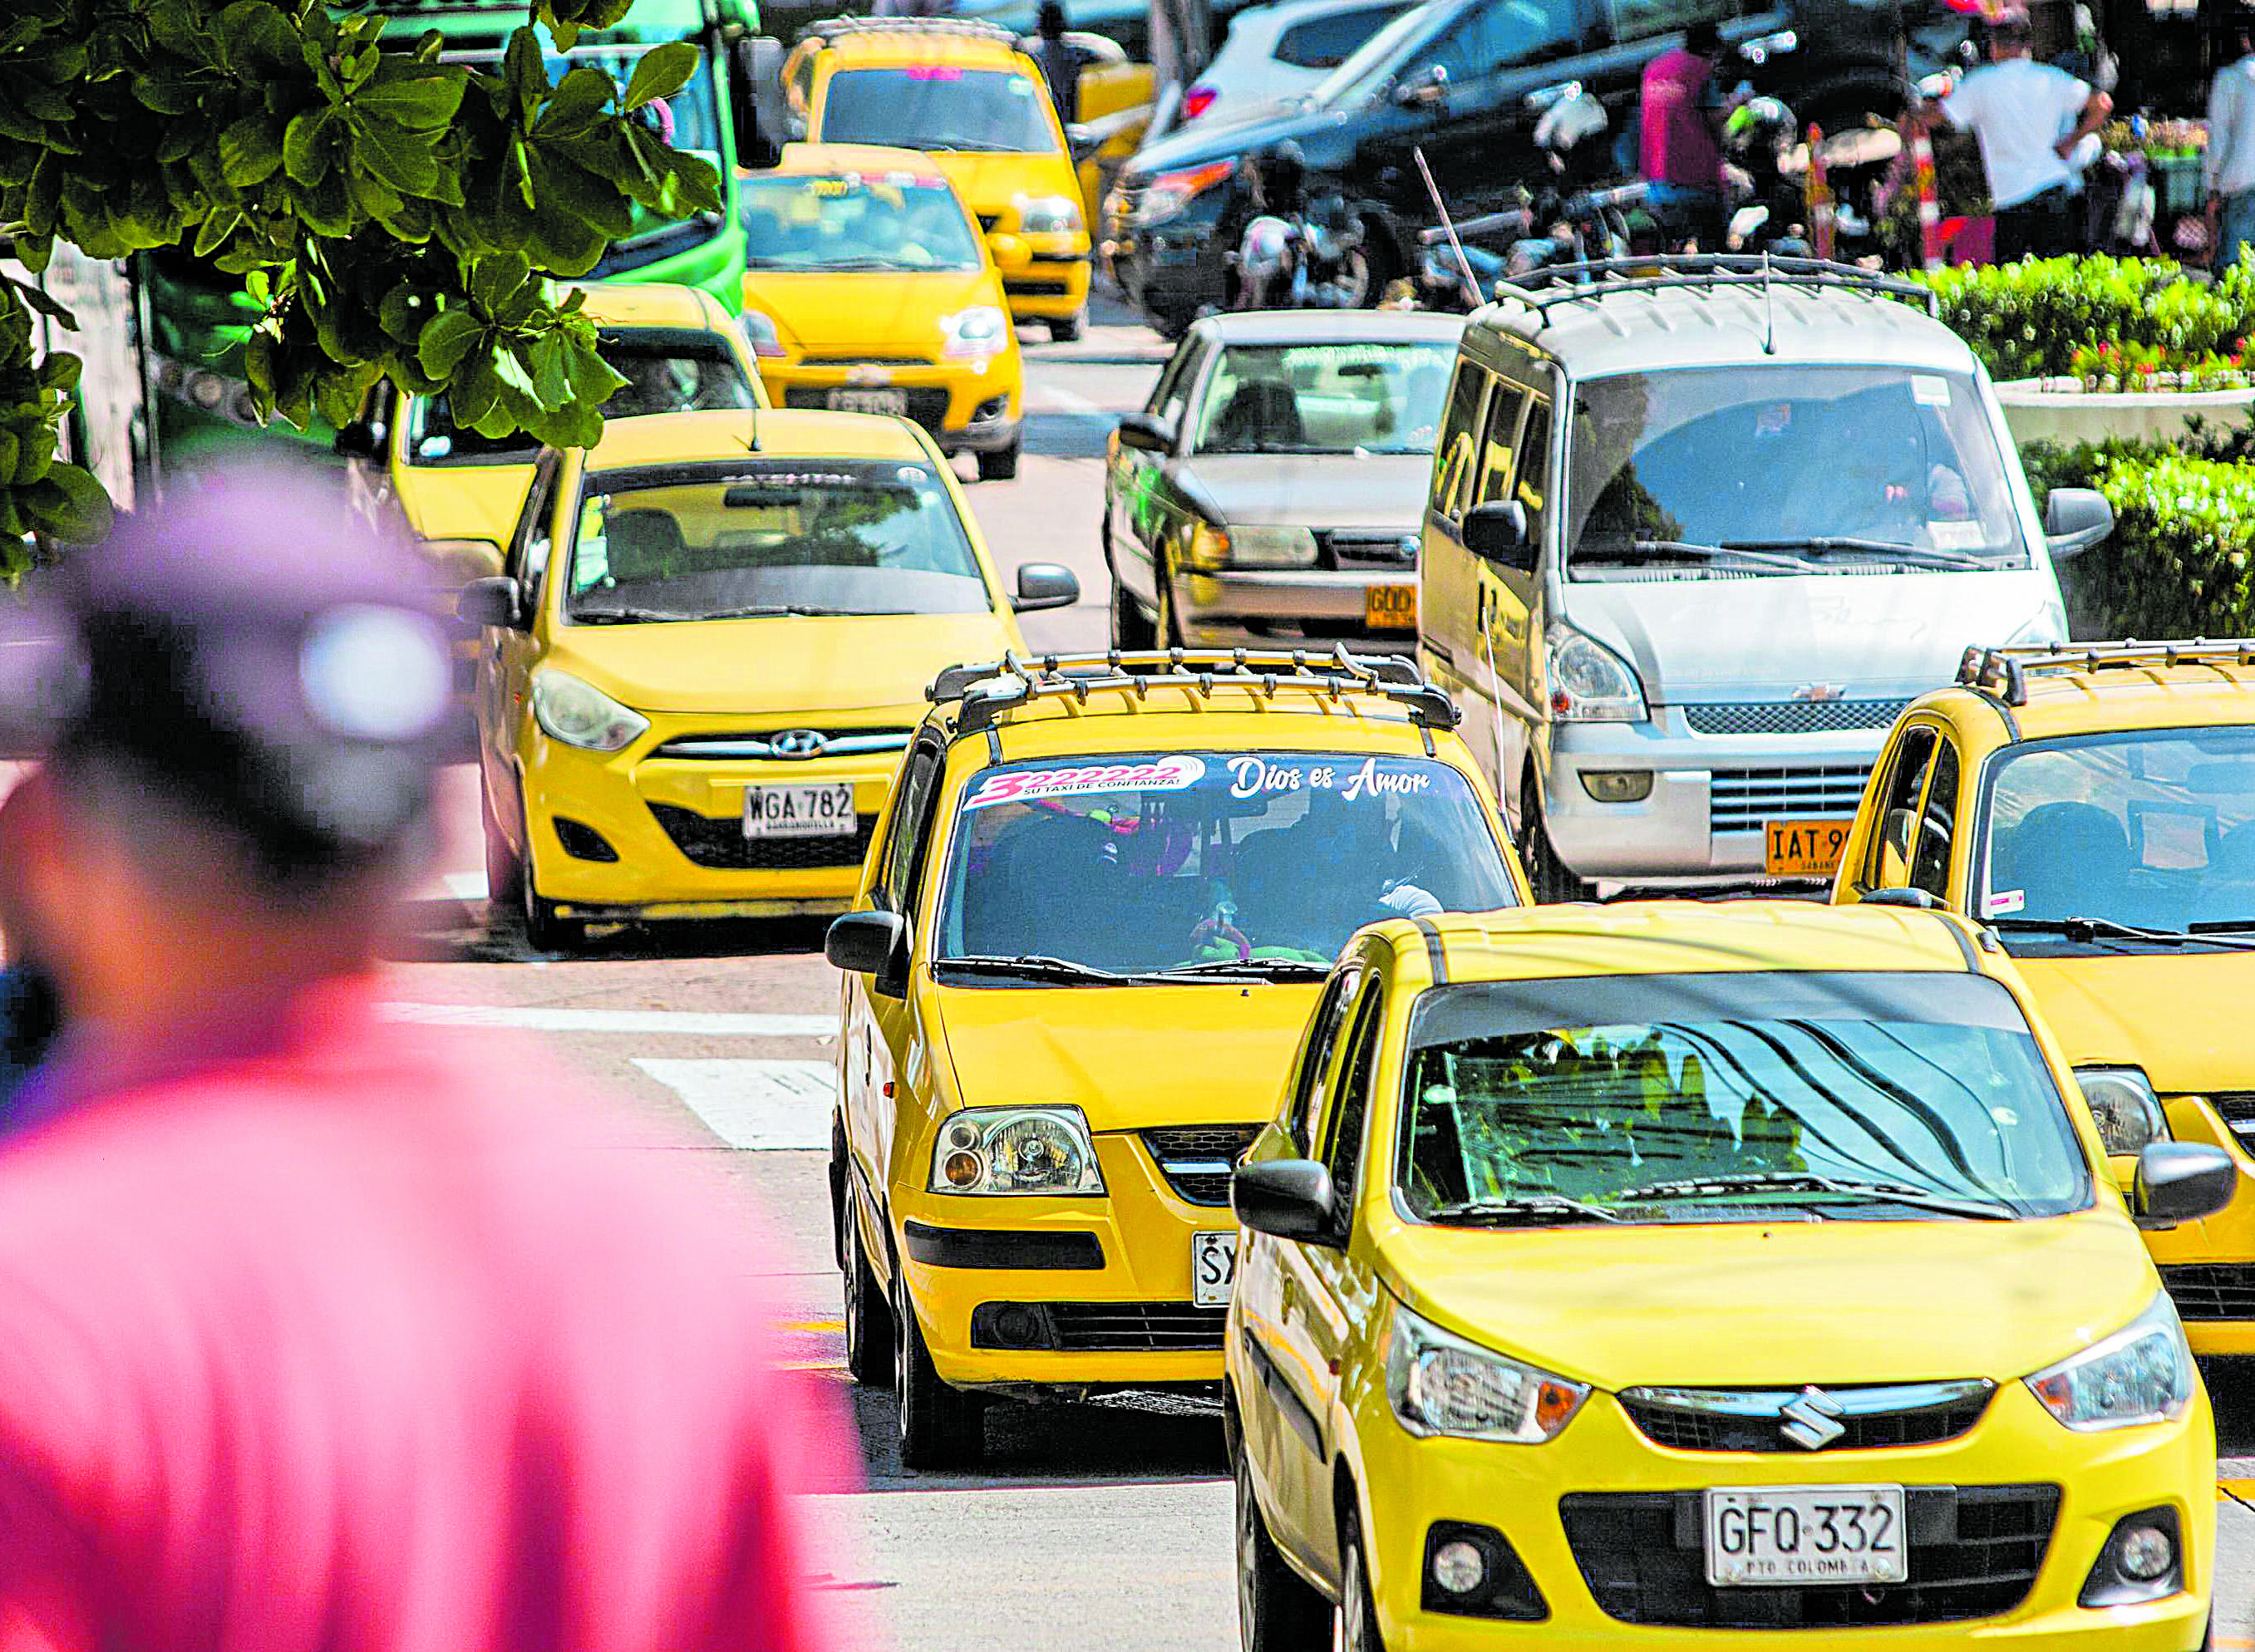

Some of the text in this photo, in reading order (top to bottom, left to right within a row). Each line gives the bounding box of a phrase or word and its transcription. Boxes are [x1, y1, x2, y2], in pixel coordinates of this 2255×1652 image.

[1023, 779, 1180, 796] SU TAXI DE CONFIANZA!
[1226, 755, 1431, 801] Dios es Amor
[750, 788, 852, 819] WGA 782
[1773, 828, 1851, 860] IAT 9
[1814, 1503, 1896, 1552] 332
